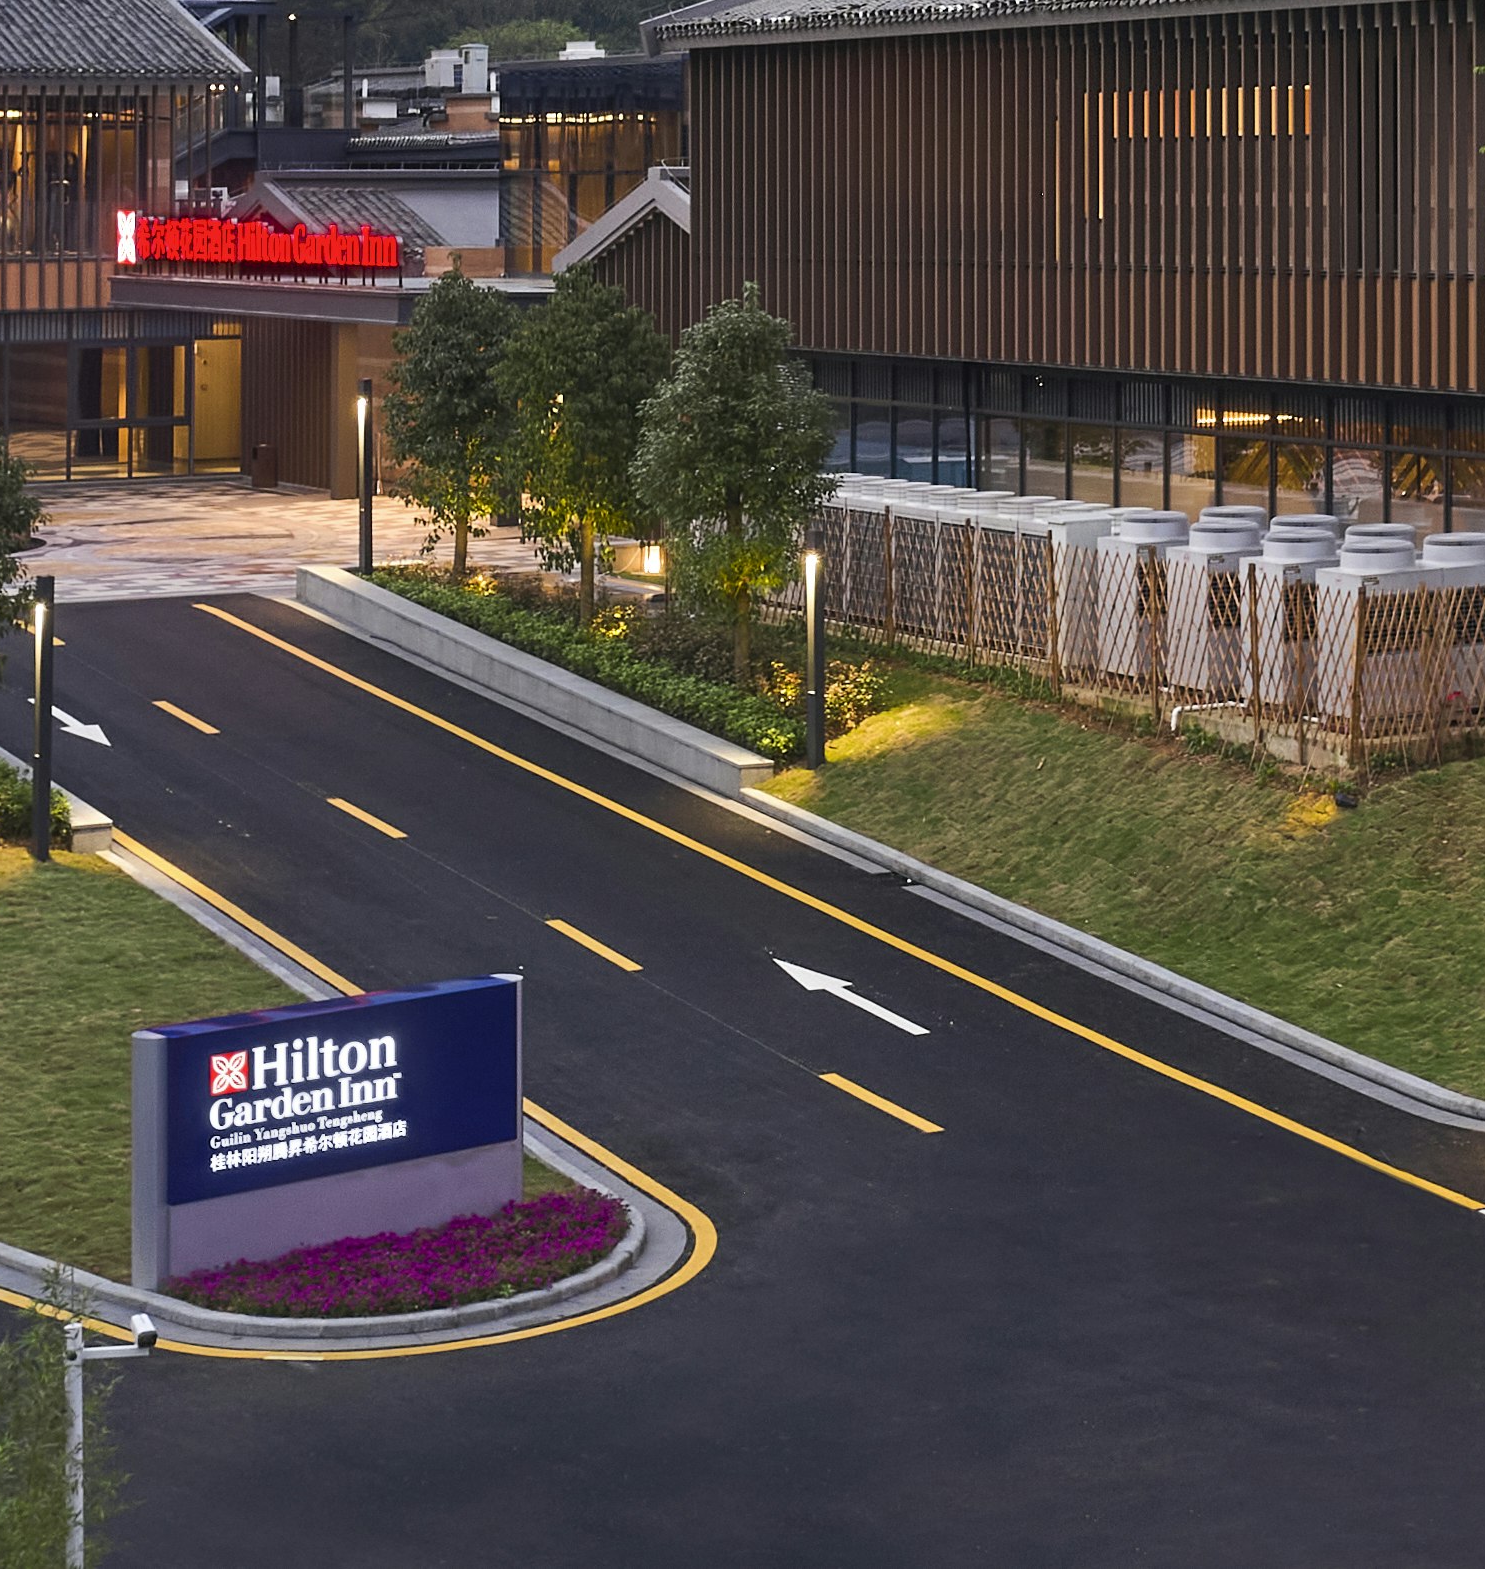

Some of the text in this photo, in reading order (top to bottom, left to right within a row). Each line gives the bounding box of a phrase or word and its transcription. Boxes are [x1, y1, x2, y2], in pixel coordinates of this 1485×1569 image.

[137, 217, 399, 267] 希尔顿花园酒店 Hilton Garden Inn
[252, 1035, 397, 1091] Hilton
[209, 1075, 399, 1130] Garden Inn
[210, 1109, 383, 1149] Guilin Yangshuo Tengsheng
